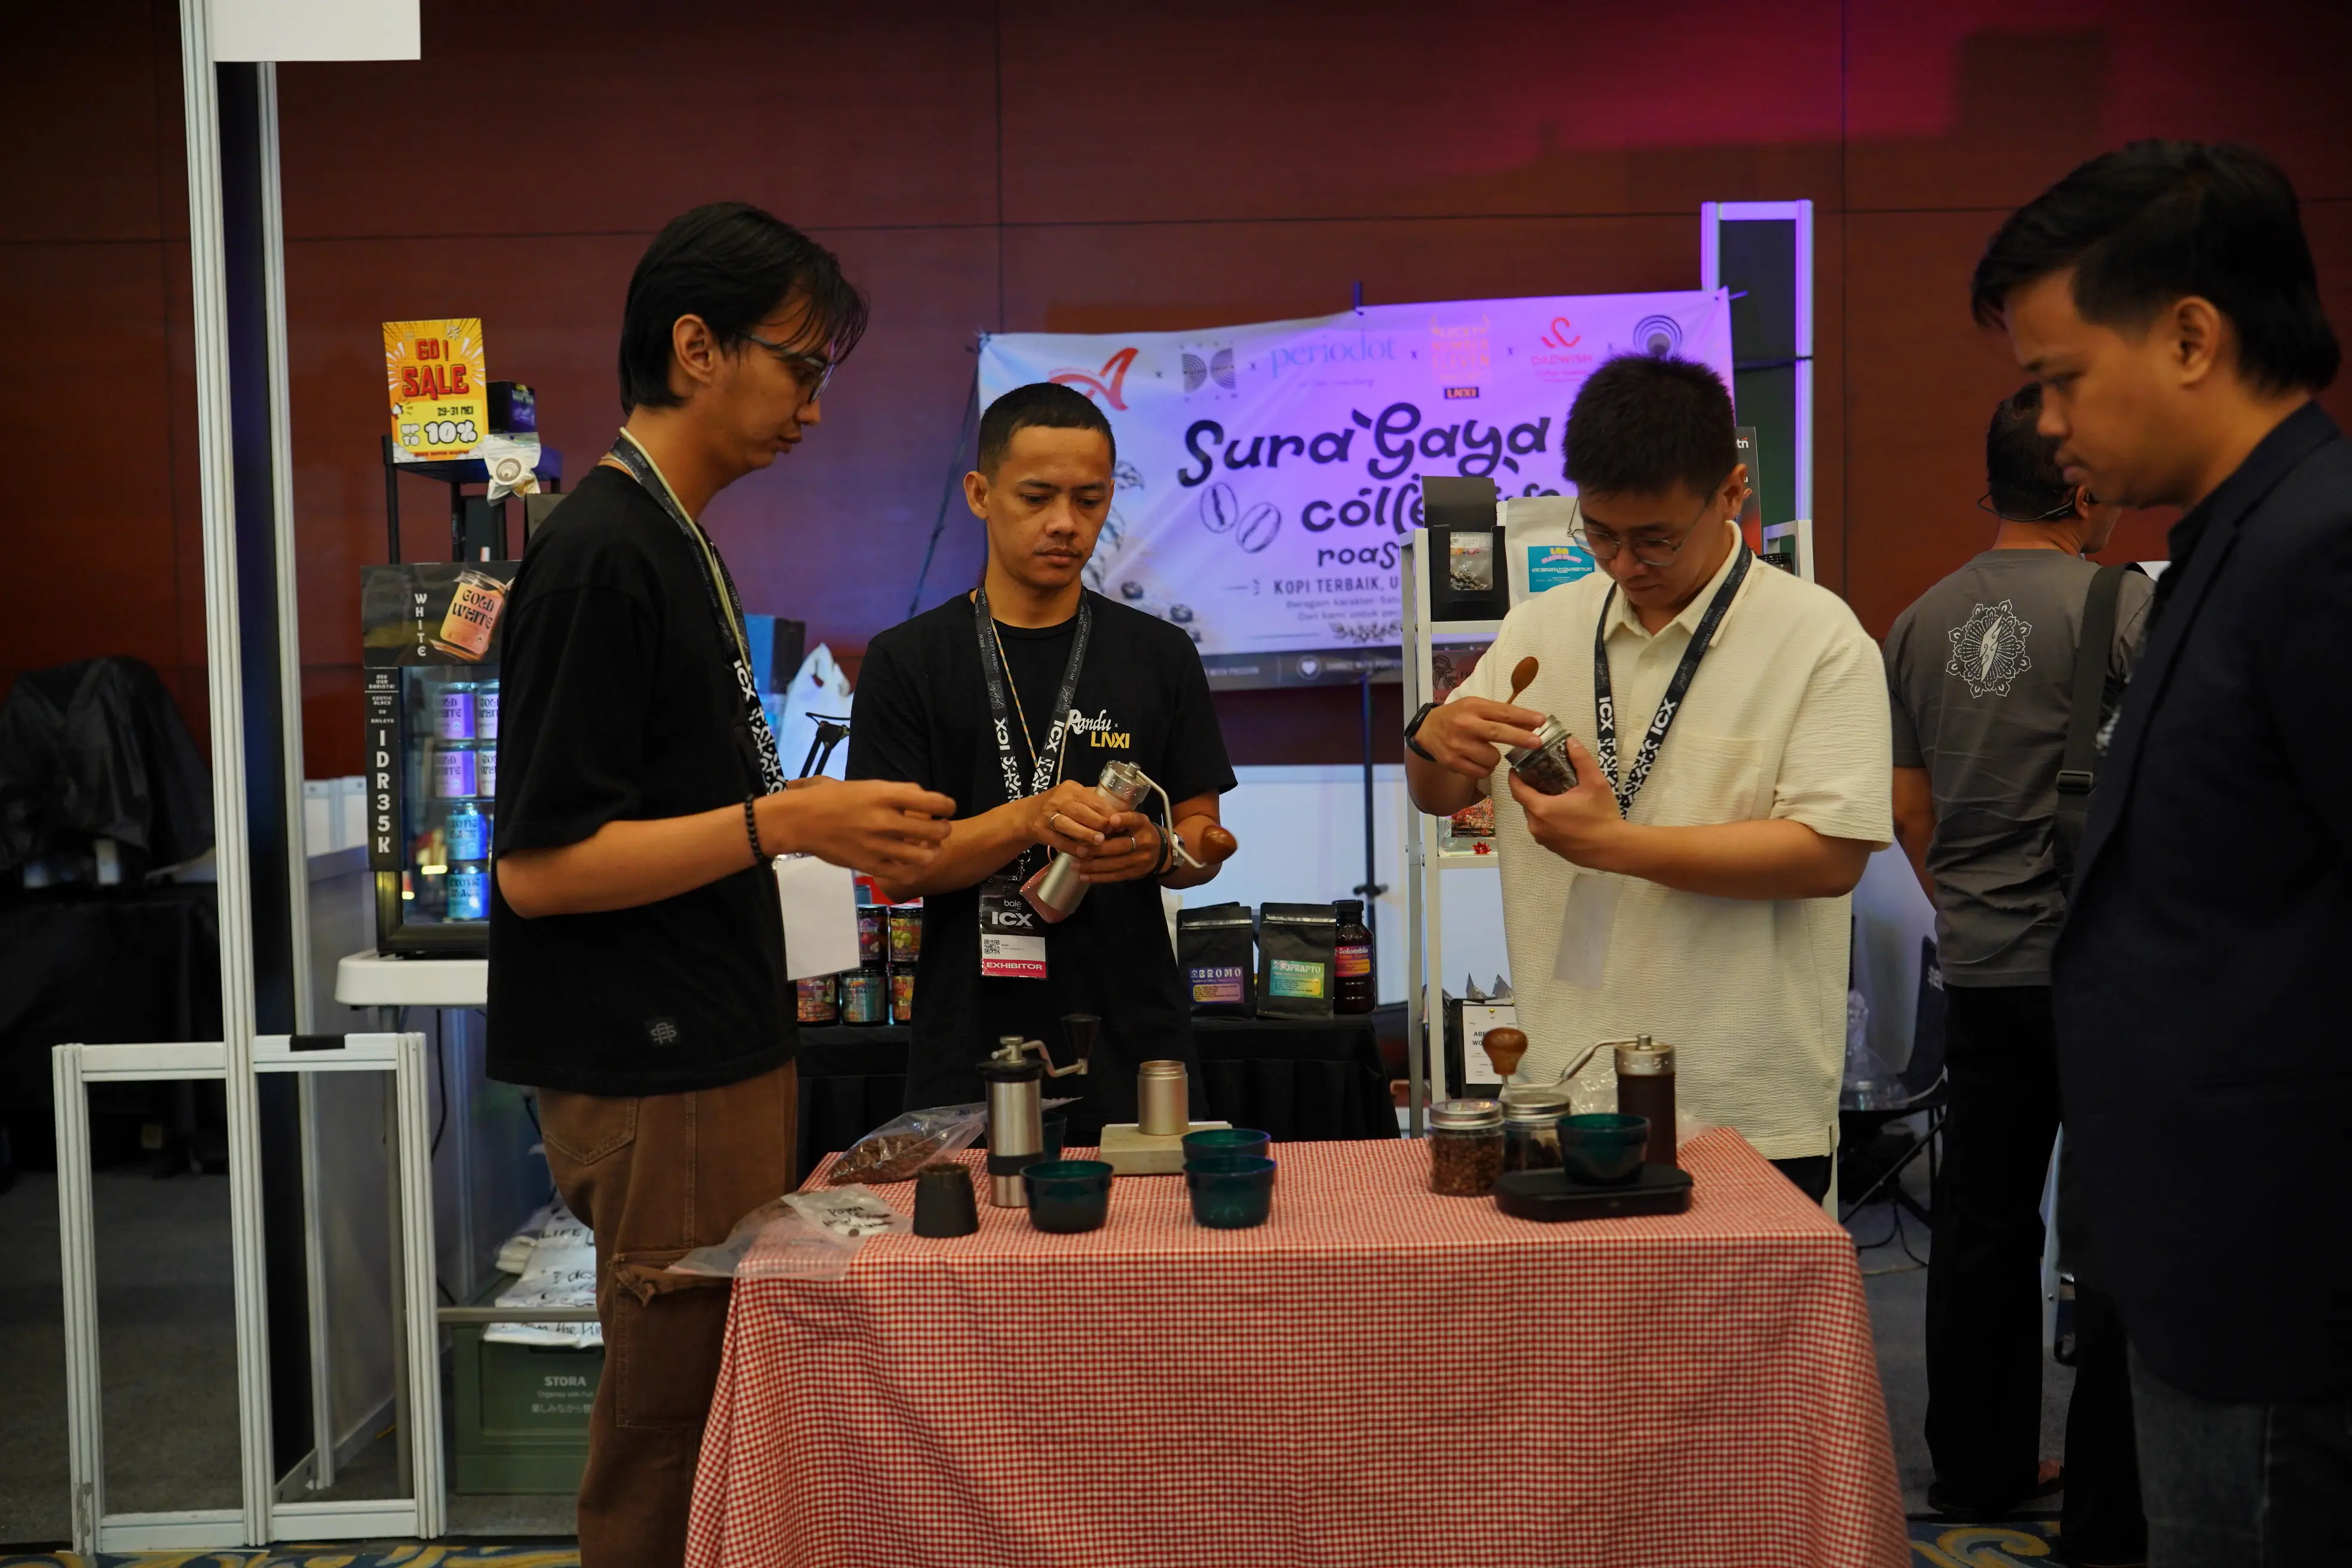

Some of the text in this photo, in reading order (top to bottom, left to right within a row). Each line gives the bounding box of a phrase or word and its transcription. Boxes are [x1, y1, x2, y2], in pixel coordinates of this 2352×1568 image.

[1271, 326, 1397, 379] periodot
[1432, 354, 1489, 368] ELEVEN
[402, 364, 470, 400] SALE
[437, 406, 473, 416] 29-31 MEI
[400, 423, 420, 435] UP
[402, 435, 420, 446] TO
[424, 419, 478, 445] 10%
[1317, 541, 1399, 569] roas
[1273, 578, 1311, 595] KOPI
[463, 590, 494, 612] COLD
[452, 602, 493, 629] WHITE
[987, 626, 996, 650] LIFESTYLE
[734, 660, 757, 702] ICX
[1069, 663, 1077, 681] STEAM
[1067, 709, 1111, 734] Randu
[1598, 696, 1614, 731] ICX
[1650, 697, 1676, 736] ICX
[994, 717, 1011, 751] ICX
[1046, 720, 1065, 753] ICX
[1091, 731, 1130, 749] LNXI
[992, 911, 1033, 927] ICX
[987, 961, 1043, 970] EXHIBITOR
[1199, 968, 1241, 978] BROMO
[543, 1375, 587, 1387] STORA
